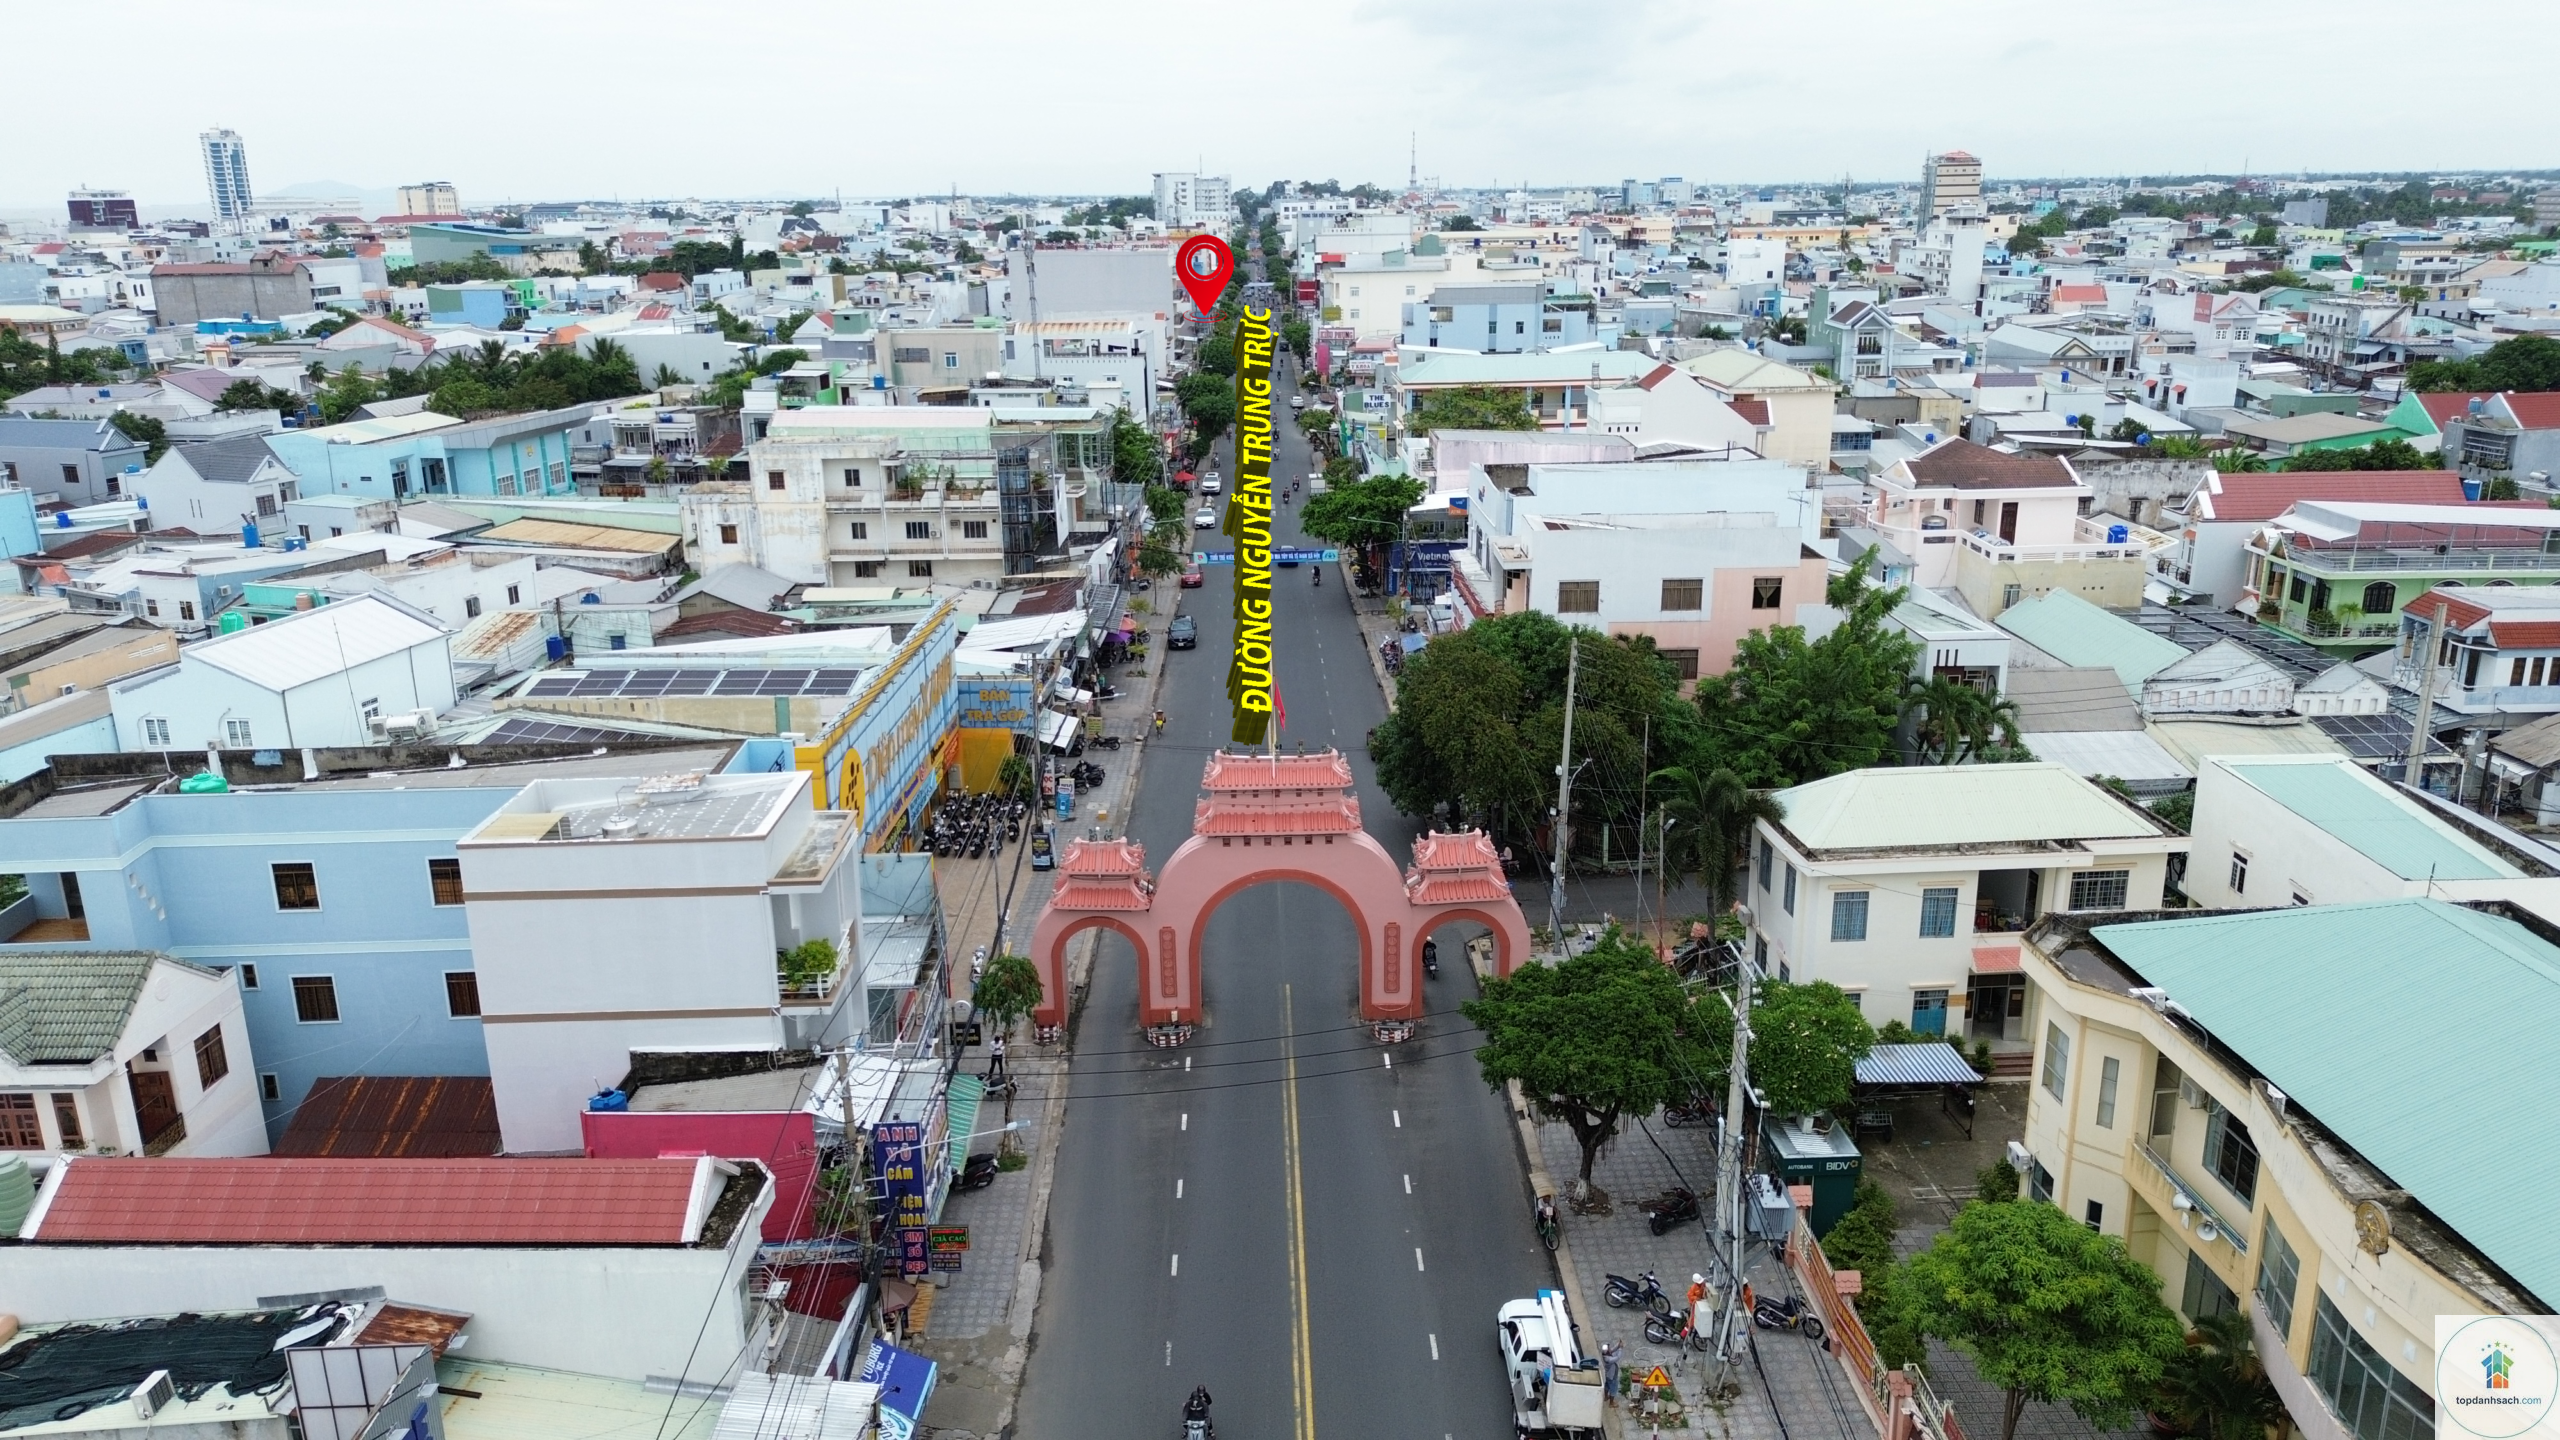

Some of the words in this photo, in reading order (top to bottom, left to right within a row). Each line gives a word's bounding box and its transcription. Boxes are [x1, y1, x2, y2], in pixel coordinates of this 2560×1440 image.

[979, 686, 1011, 702] BÁN
[965, 705, 994, 722] TRẢ
[997, 706, 1027, 722] GÓP
[877, 1126, 918, 1142] ANH
[885, 1142, 912, 1161] VŨ
[1826, 1161, 1850, 1171] BIDV
[904, 1231, 924, 1243] SIM
[907, 1243, 923, 1257] SỐ
[906, 1261, 927, 1274] ĐẸP
[861, 1343, 884, 1380] TUBORG
[876, 1359, 885, 1371] ICE
